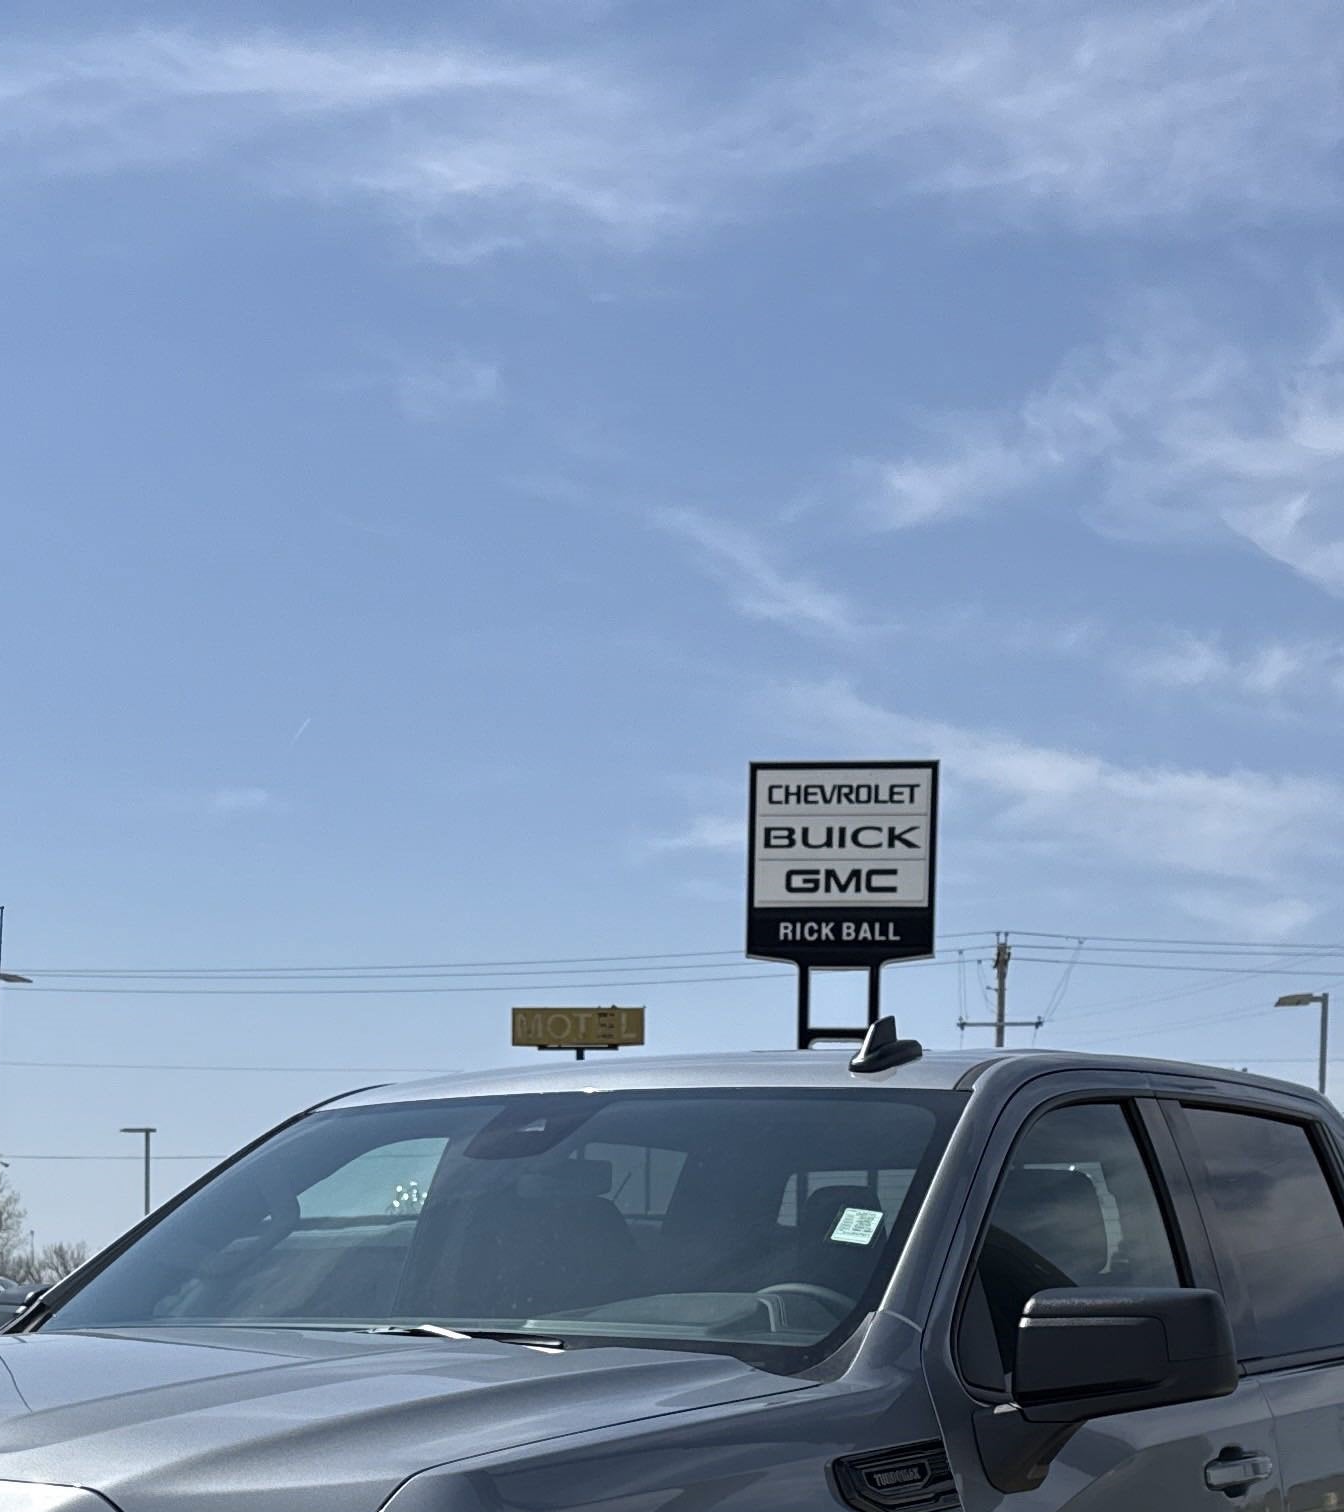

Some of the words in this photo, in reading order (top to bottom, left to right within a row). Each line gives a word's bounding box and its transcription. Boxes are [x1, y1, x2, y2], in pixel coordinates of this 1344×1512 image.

[767, 783, 920, 806] CHEVROLET
[763, 825, 921, 850] BUICK
[784, 868, 899, 894] GMC
[779, 922, 834, 941] RICK
[842, 922, 900, 941] BALL
[516, 1012, 637, 1040] MOTEL
